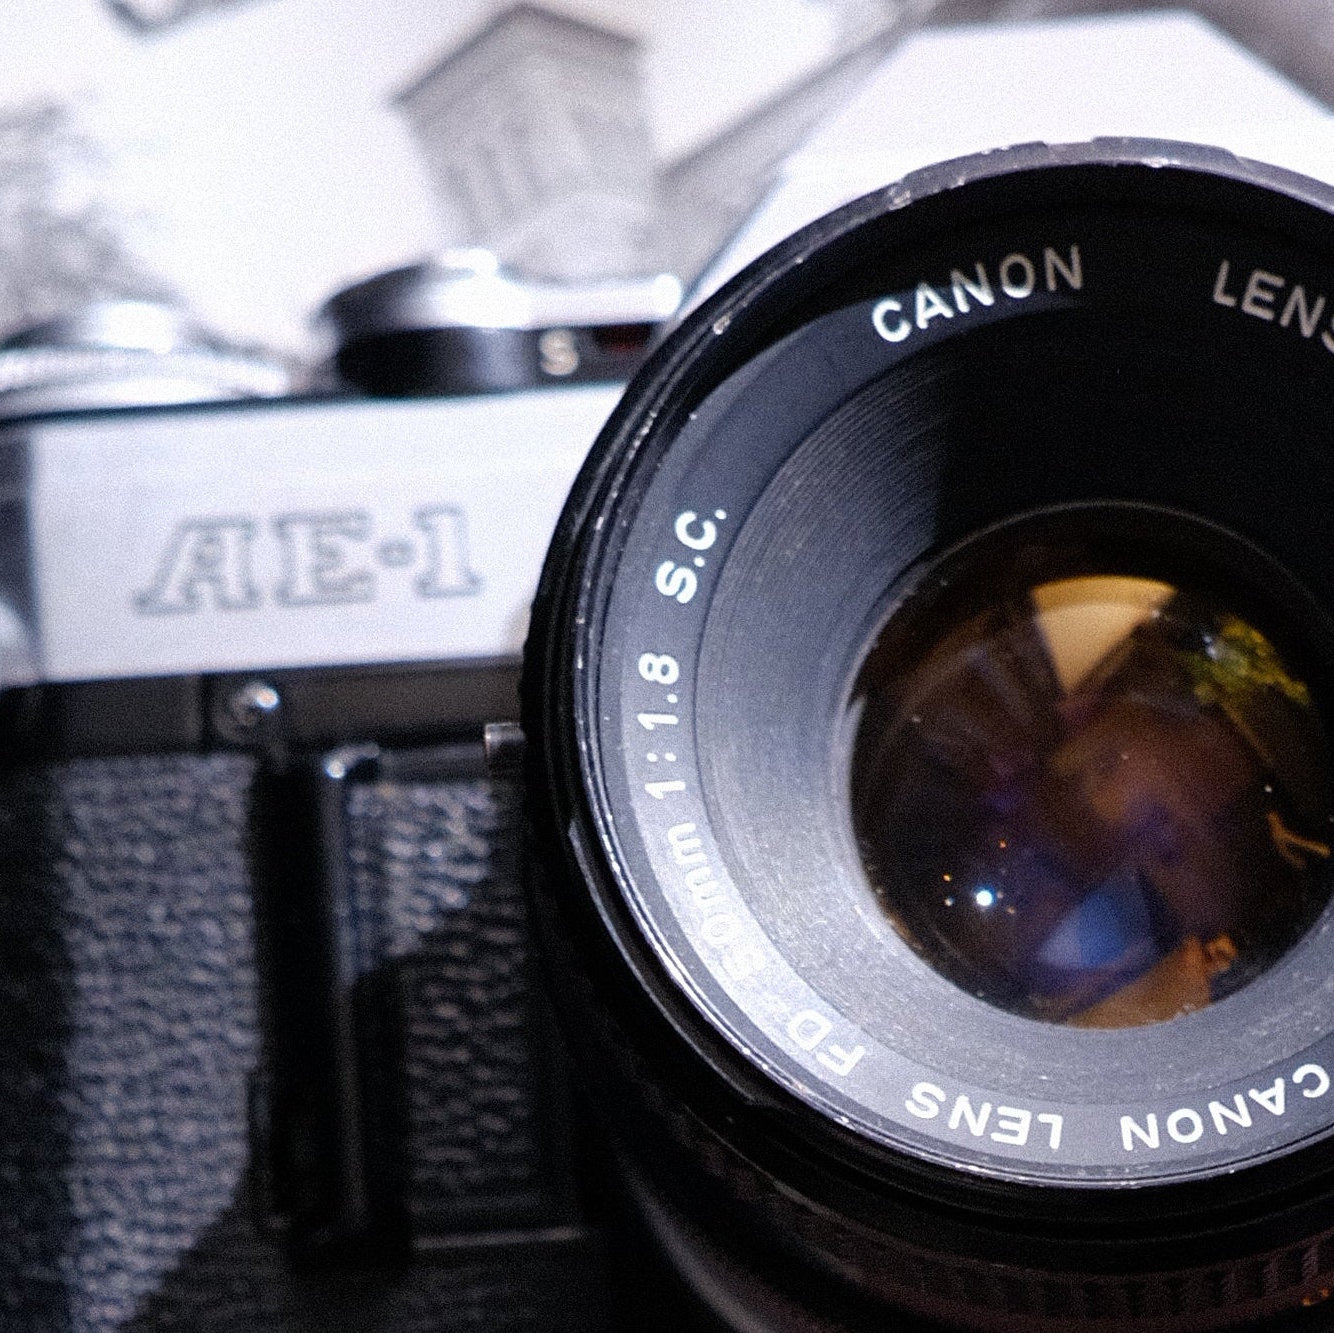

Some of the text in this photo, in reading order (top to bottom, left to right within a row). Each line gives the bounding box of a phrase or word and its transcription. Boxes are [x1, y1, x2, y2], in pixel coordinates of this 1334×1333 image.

[869, 246, 1084, 345] CANON
[540, 329, 578, 376] S
[654, 509, 727, 604] S.C.
[636, 652, 687, 801] 1:1.8
[786, 1007, 868, 1078] FD
[903, 1082, 1066, 1152] LENS
[1118, 1062, 1332, 1153] CANON
